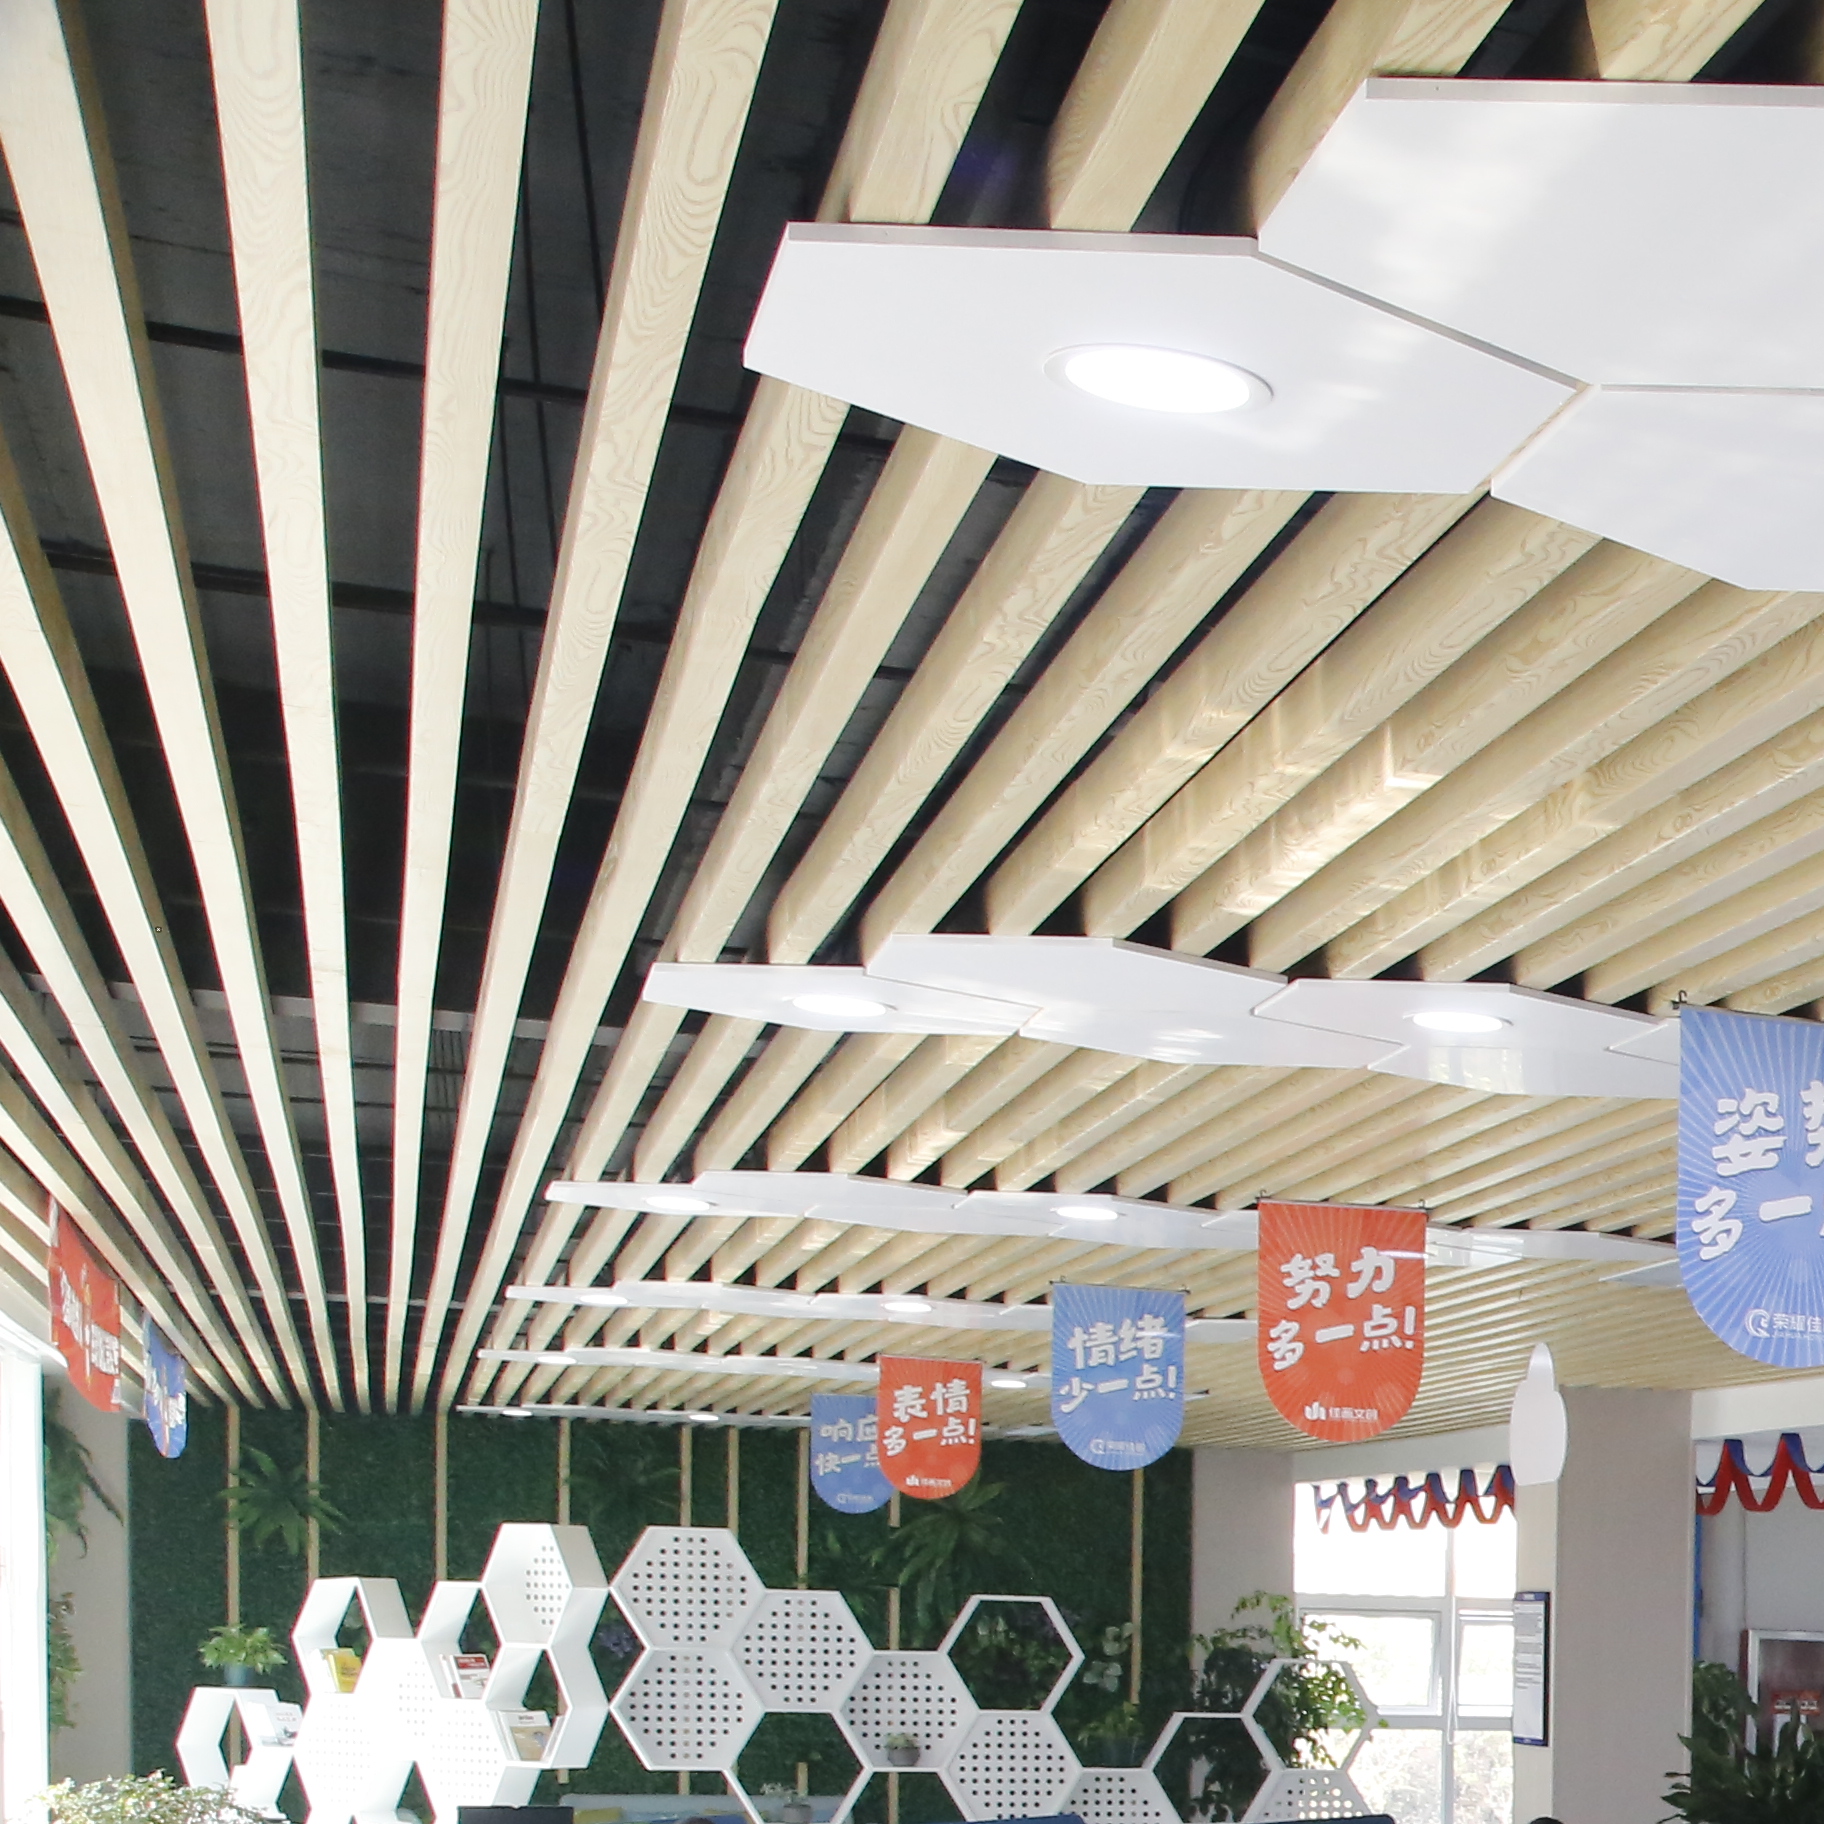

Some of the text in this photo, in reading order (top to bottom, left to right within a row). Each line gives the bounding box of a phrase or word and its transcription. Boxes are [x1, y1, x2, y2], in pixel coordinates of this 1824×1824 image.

[1280, 1245, 1396, 1310] 努力
[1066, 1313, 1168, 1370] 情绪
[1266, 1303, 1416, 1372] 多一点!
[892, 1378, 971, 1423] 表情
[1059, 1364, 1177, 1414] 少一点!
[882, 1416, 977, 1457] 多一点!
